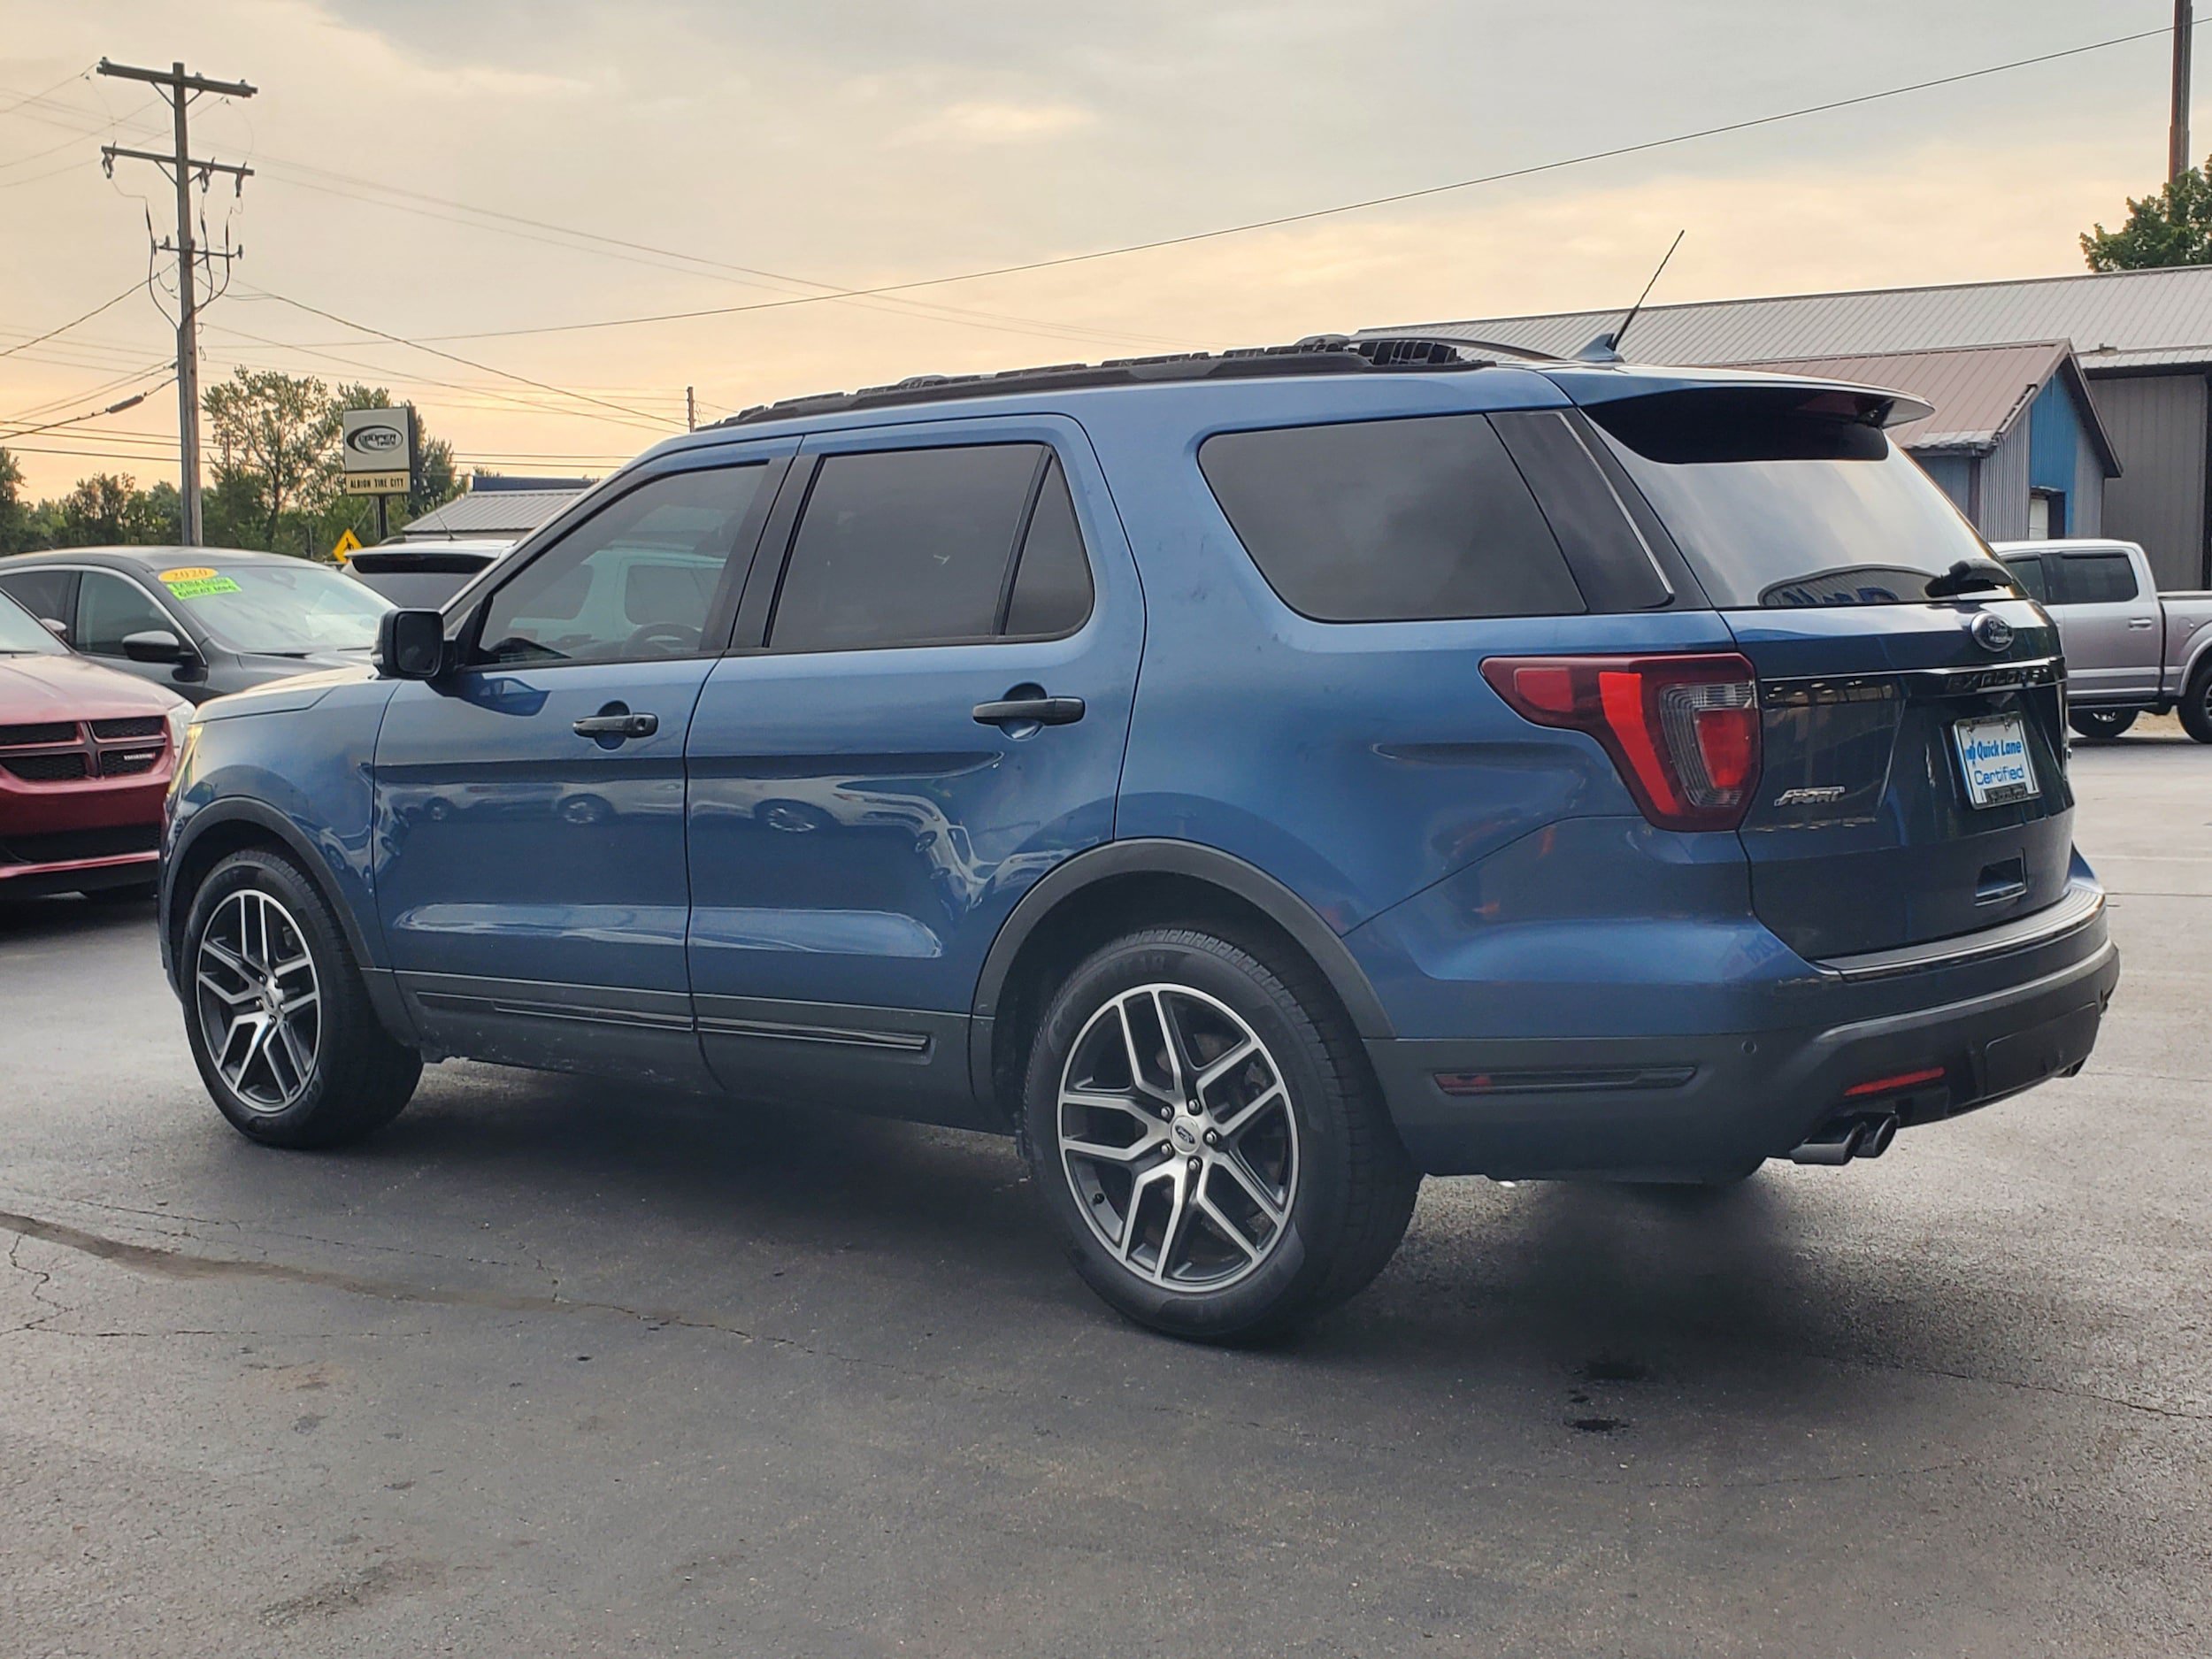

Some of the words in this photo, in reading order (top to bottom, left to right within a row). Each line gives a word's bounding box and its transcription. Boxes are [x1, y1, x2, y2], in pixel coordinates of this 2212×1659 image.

[349, 480, 372, 488] ALBION
[374, 479, 388, 488] TIRE
[390, 478, 403, 488] CITY
[173, 568, 209, 580] 2020
[1977, 740, 2000, 761] Quick
[2001, 739, 2022, 756] Lane
[1974, 764, 2024, 786] Certified
